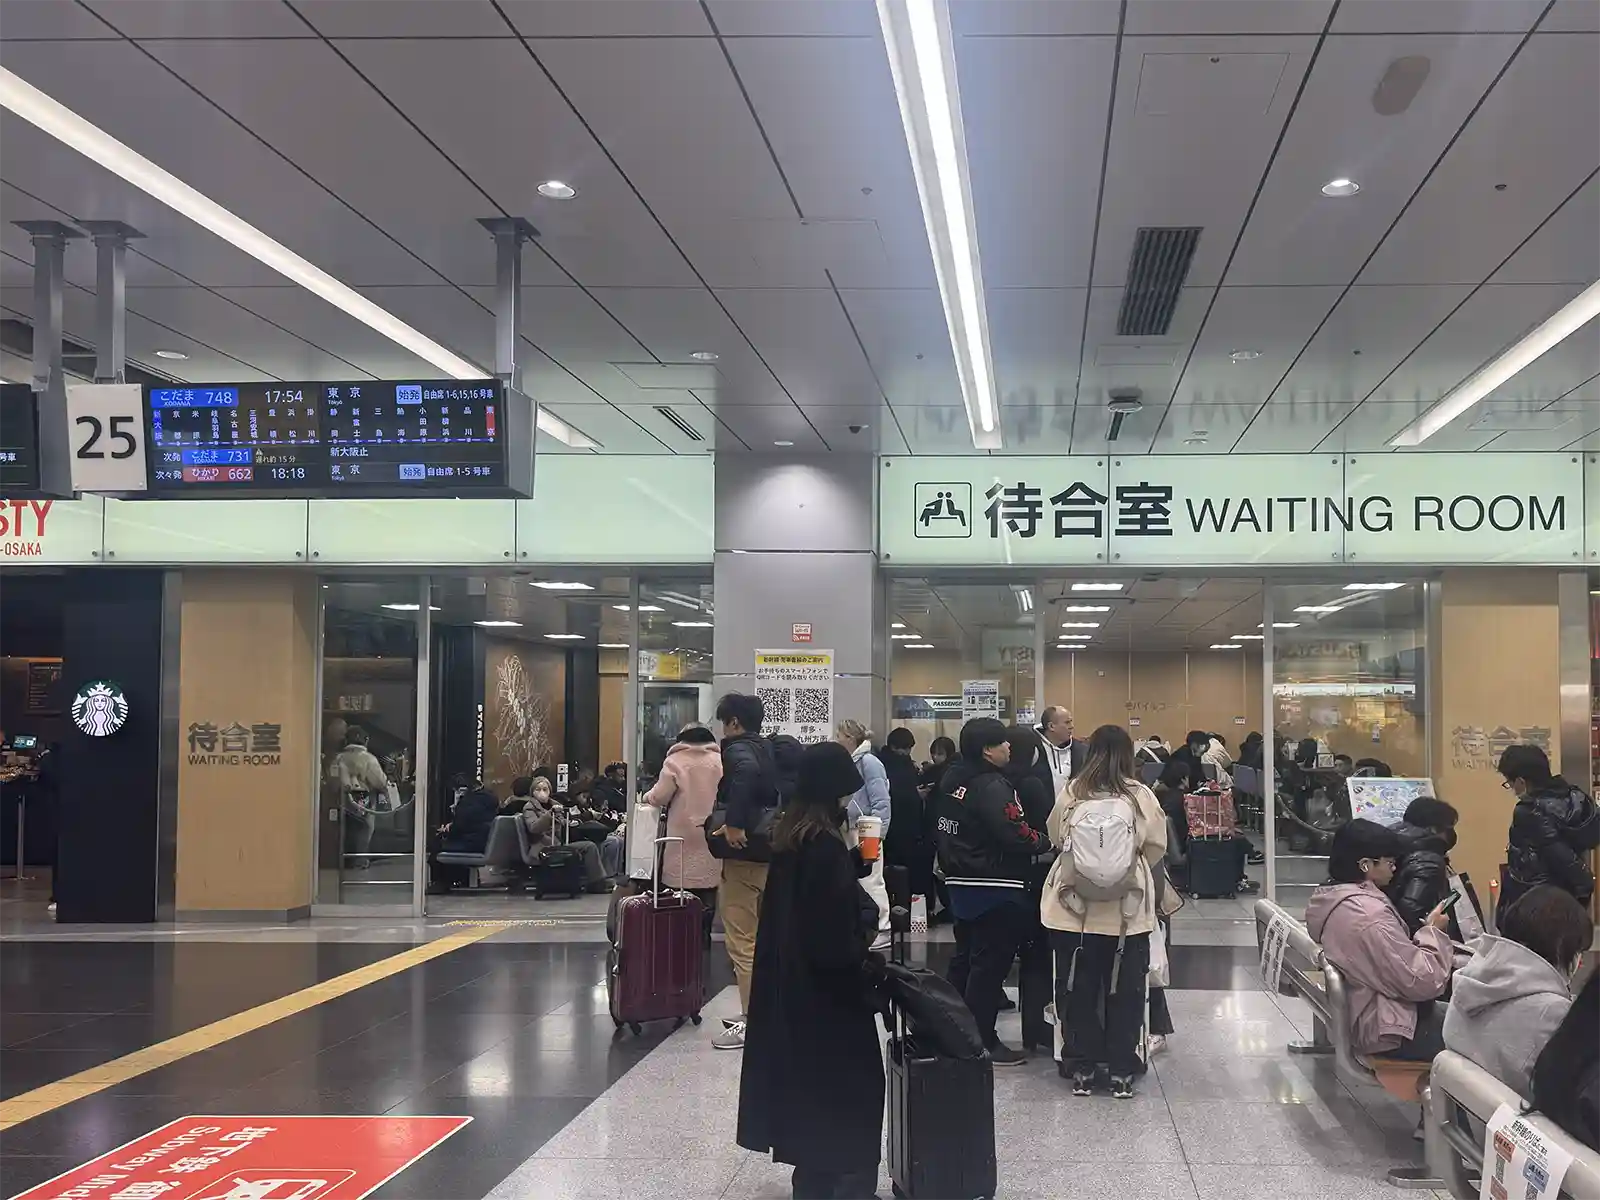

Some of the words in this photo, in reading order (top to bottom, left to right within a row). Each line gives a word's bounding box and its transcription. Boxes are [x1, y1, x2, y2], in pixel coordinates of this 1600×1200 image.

[160, 390, 194, 401] こだま
[206, 391, 232, 404] 748
[265, 390, 303, 404] 17:54
[327, 386, 361, 399] 東京
[423, 389, 444, 400] 自由席
[446, 389, 478, 400] 1-6,15,16
[480, 388, 494, 399] 号車
[76, 416, 137, 459] 25
[163, 452, 181, 462] 次発
[191, 450, 219, 459] こだま
[227, 450, 249, 462] 731
[330, 447, 369, 457] 新大阪止
[279, 456, 288, 464] 15
[289, 455, 296, 463] 分
[155, 470, 182, 480] 次々発
[191, 468, 219, 477] ひかり
[228, 468, 251, 480] 662
[271, 468, 305, 479] 18:18
[331, 464, 361, 475] 東京
[427, 467, 453, 477] 自由席
[456, 467, 471, 476] 1-5
[472, 467, 491, 476] 号車
[984, 481, 1174, 539] 待合室
[1185, 495, 1393, 534] WAITING
[1413, 494, 1567, 533] ROOM
[188, 722, 281, 752] 待合室
[188, 755, 240, 766] WAITING
[243, 755, 281, 766] ROOM
[1451, 759, 1499, 769] WAITIN
[110, 1126, 222, 1172] Subway
[158, 1126, 277, 1174] 地下鉄
